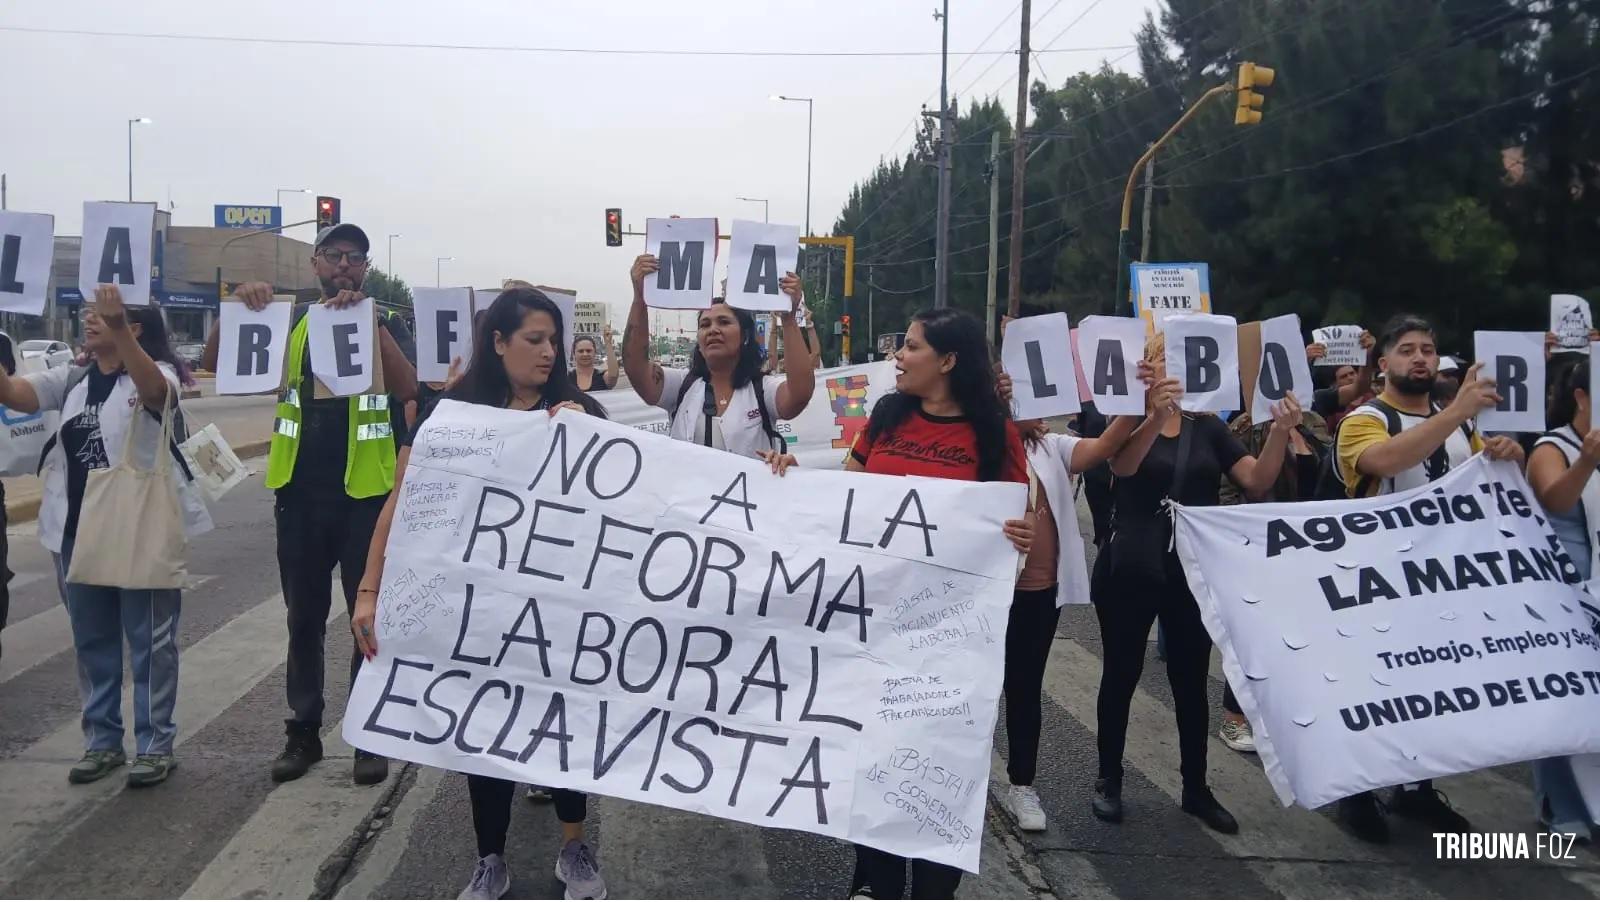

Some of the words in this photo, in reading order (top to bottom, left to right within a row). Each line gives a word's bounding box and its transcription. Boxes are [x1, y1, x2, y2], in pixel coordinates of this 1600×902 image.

[1, 235, 24, 294] L
[97, 227, 135, 285] A
[656, 241, 704, 290] M
[743, 244, 779, 295] A
[1150, 296, 1192, 309] FATE
[236, 324, 272, 376] R
[332, 323, 363, 378] E
[437, 310, 457, 364] F
[1184, 336, 1222, 393] B
[1024, 340, 1058, 398] L
[1093, 339, 1129, 396] A
[1260, 342, 1294, 400] O
[1495, 355, 1528, 412] R
[528, 423, 642, 500] NO
[698, 471, 757, 531] A
[839, 488, 938, 557] LA
[1266, 487, 1484, 558] Agencia
[1479, 481, 1532, 518] Te
[462, 486, 873, 643] REFORMA
[1318, 566, 1401, 611] LA
[451, 583, 863, 732] LABORAL
[1377, 638, 1482, 670] Trabajo,
[1482, 630, 1559, 654] Empleo
[1560, 631, 1571, 649] y
[1571, 628, 1600, 651] Seg
[1339, 686, 1481, 732] UNIDAD
[1482, 678, 1528, 708] DE
[1527, 671, 1585, 701] LOS
[1583, 670, 1600, 695] T
[362, 657, 830, 825] ESCLAVISTA
